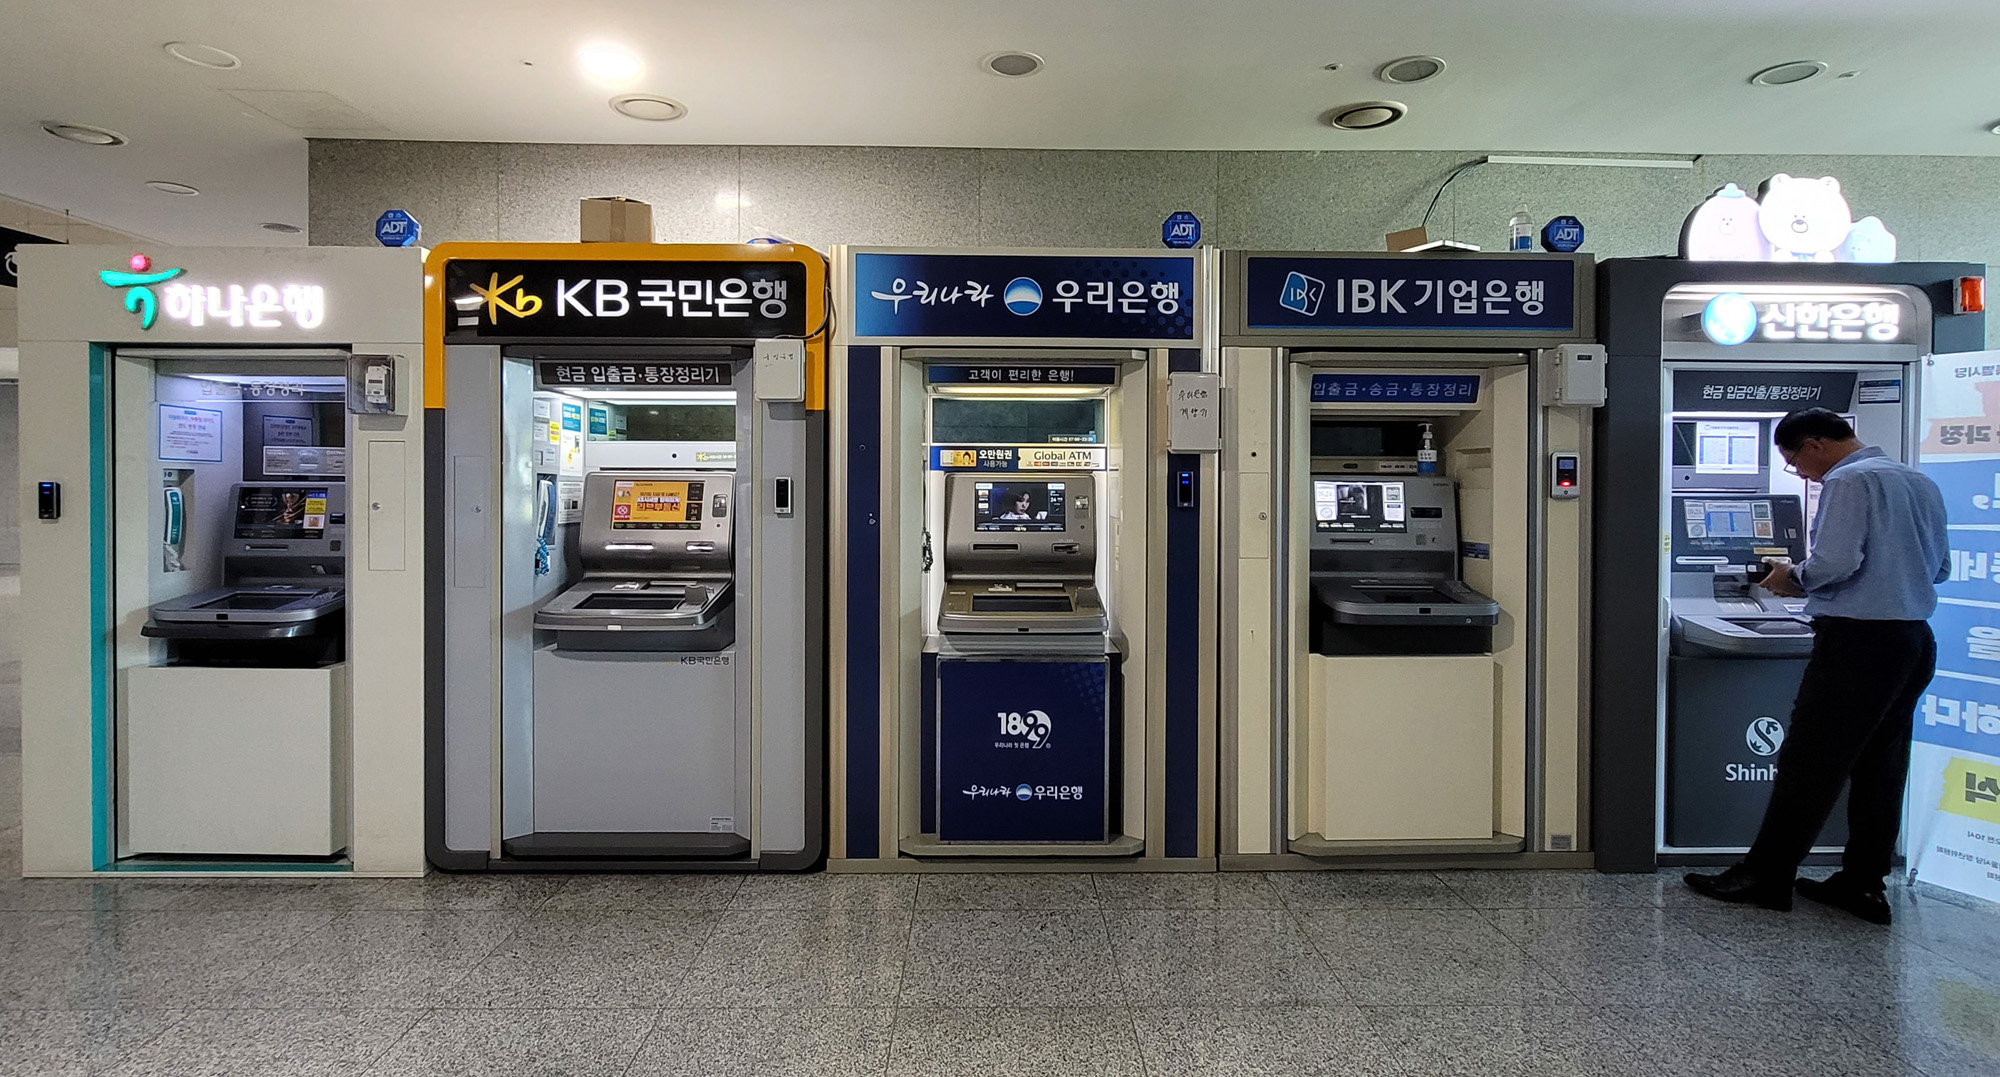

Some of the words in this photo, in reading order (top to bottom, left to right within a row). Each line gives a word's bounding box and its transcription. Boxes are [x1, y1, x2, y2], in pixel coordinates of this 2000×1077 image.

[381, 221, 407, 234] ADT
[1170, 223, 1195, 236] ADT
[1554, 228, 1579, 241] ADT
[556, 278, 630, 318] KB
[637, 277, 788, 320] 국민은행
[870, 277, 995, 316] 우리나라
[1052, 279, 1180, 316] 우리은행
[1337, 278, 1408, 314] IBK
[1413, 278, 1546, 316] 기업은행
[163, 283, 325, 329] 하나은행
[1760, 302, 1900, 341] 신한은행
[555, 365, 587, 382] 현금
[590, 365, 721, 383] 입출금·통장정리기
[968, 369, 1002, 381] 고객이
[1008, 369, 1042, 382] 편리한
[1047, 369, 1074, 382] 은행!
[1703, 385, 1724, 399] 현금
[1726, 385, 1822, 400] 입금인출/통장정리기
[978, 449, 1013, 460] 오만원권
[1033, 451, 1066, 461] Global
[1068, 451, 1092, 461] ATM
[983, 460, 1008, 468] 사용가능
[680, 655, 730, 666] KB국민은행
[997, 710, 1052, 749] 1899
[962, 784, 1013, 800] 우리나라
[1033, 785, 1083, 800] 우리은행
